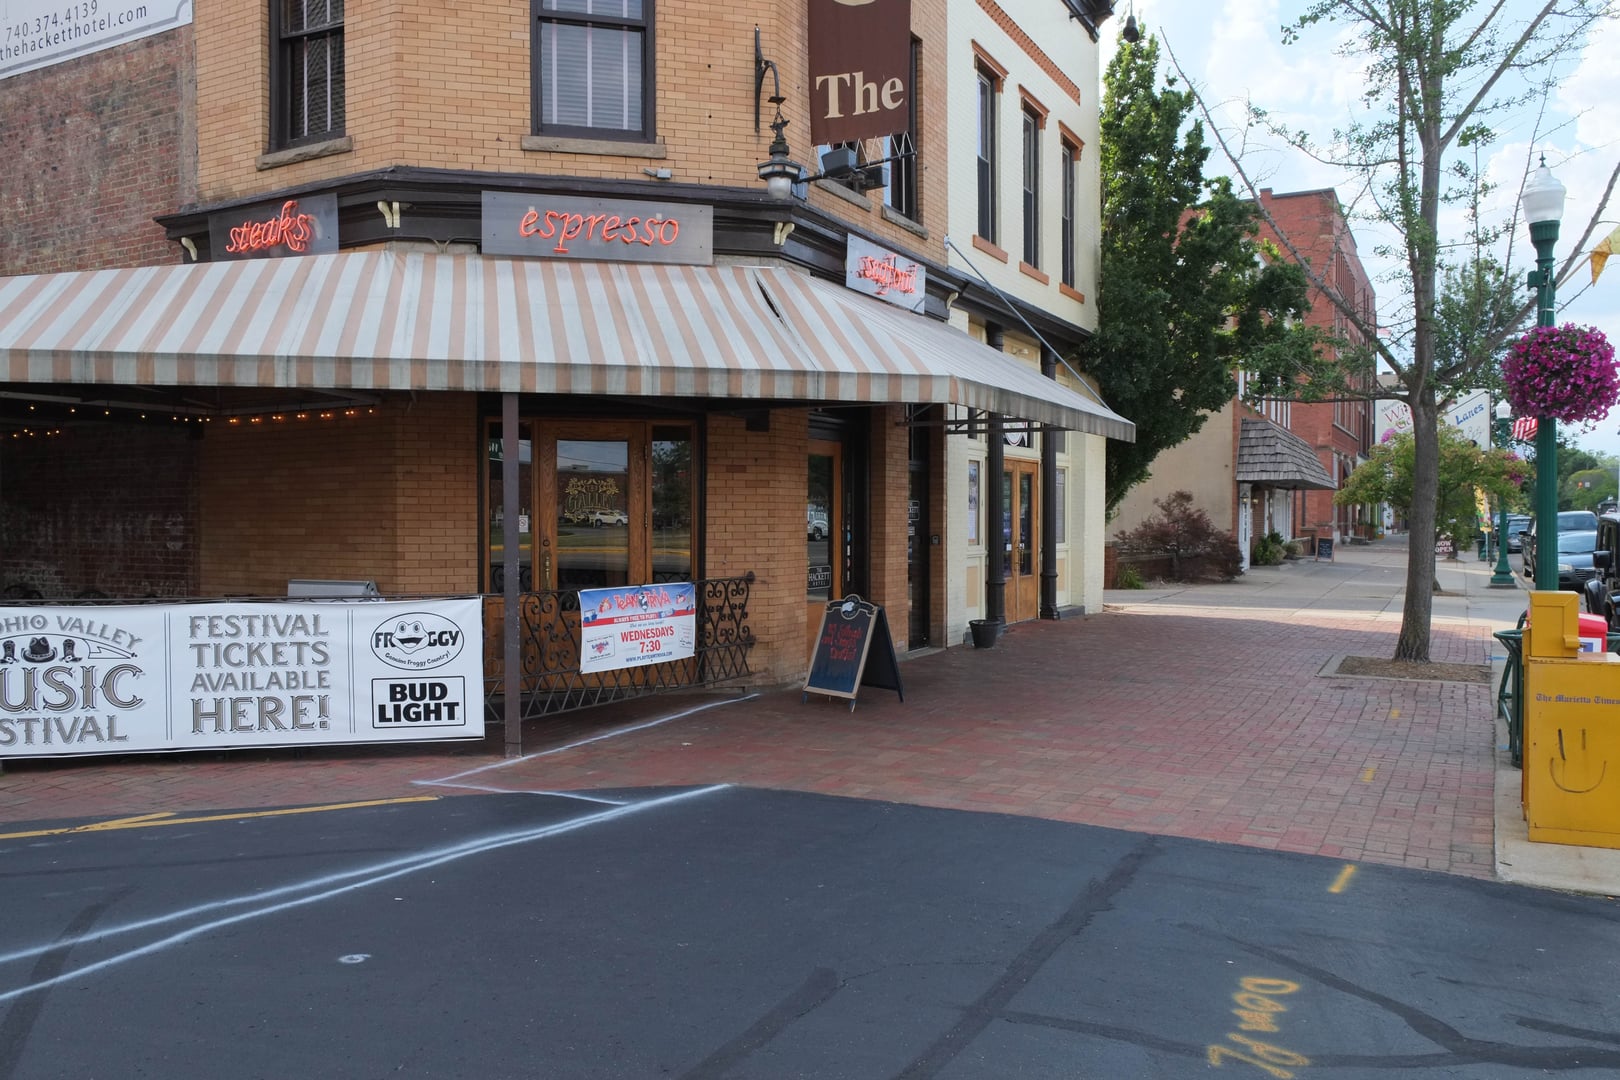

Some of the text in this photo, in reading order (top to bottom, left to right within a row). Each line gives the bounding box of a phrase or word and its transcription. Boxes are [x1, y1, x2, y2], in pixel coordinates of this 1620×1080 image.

[6, 0, 98, 42] 740.374.4139
[0, 5, 147, 61] thehacketthotel.com
[816, 71, 905, 119] The
[225, 200, 310, 253] steaks
[519, 209, 681, 254] espresso
[1455, 404, 1484, 425] Lanes
[0, 614, 142, 649] HIO VALLEY
[189, 614, 329, 639] FESTIVAL
[621, 626, 674, 642] WEDNESDAYS
[375, 630, 460, 648] FRGGY
[639, 639, 661, 653] 7:30
[190, 642, 330, 668] TICKETS
[407, 659, 427, 667] Froggy
[427, 650, 451, 665] Country!
[190, 670, 331, 692] AVAILABLE
[389, 682, 448, 702] BUD
[1536, 693, 1552, 702] The
[1555, 694, 1591, 703] Marietta
[191, 695, 330, 734] HERE!
[378, 702, 459, 722] LIGHT
